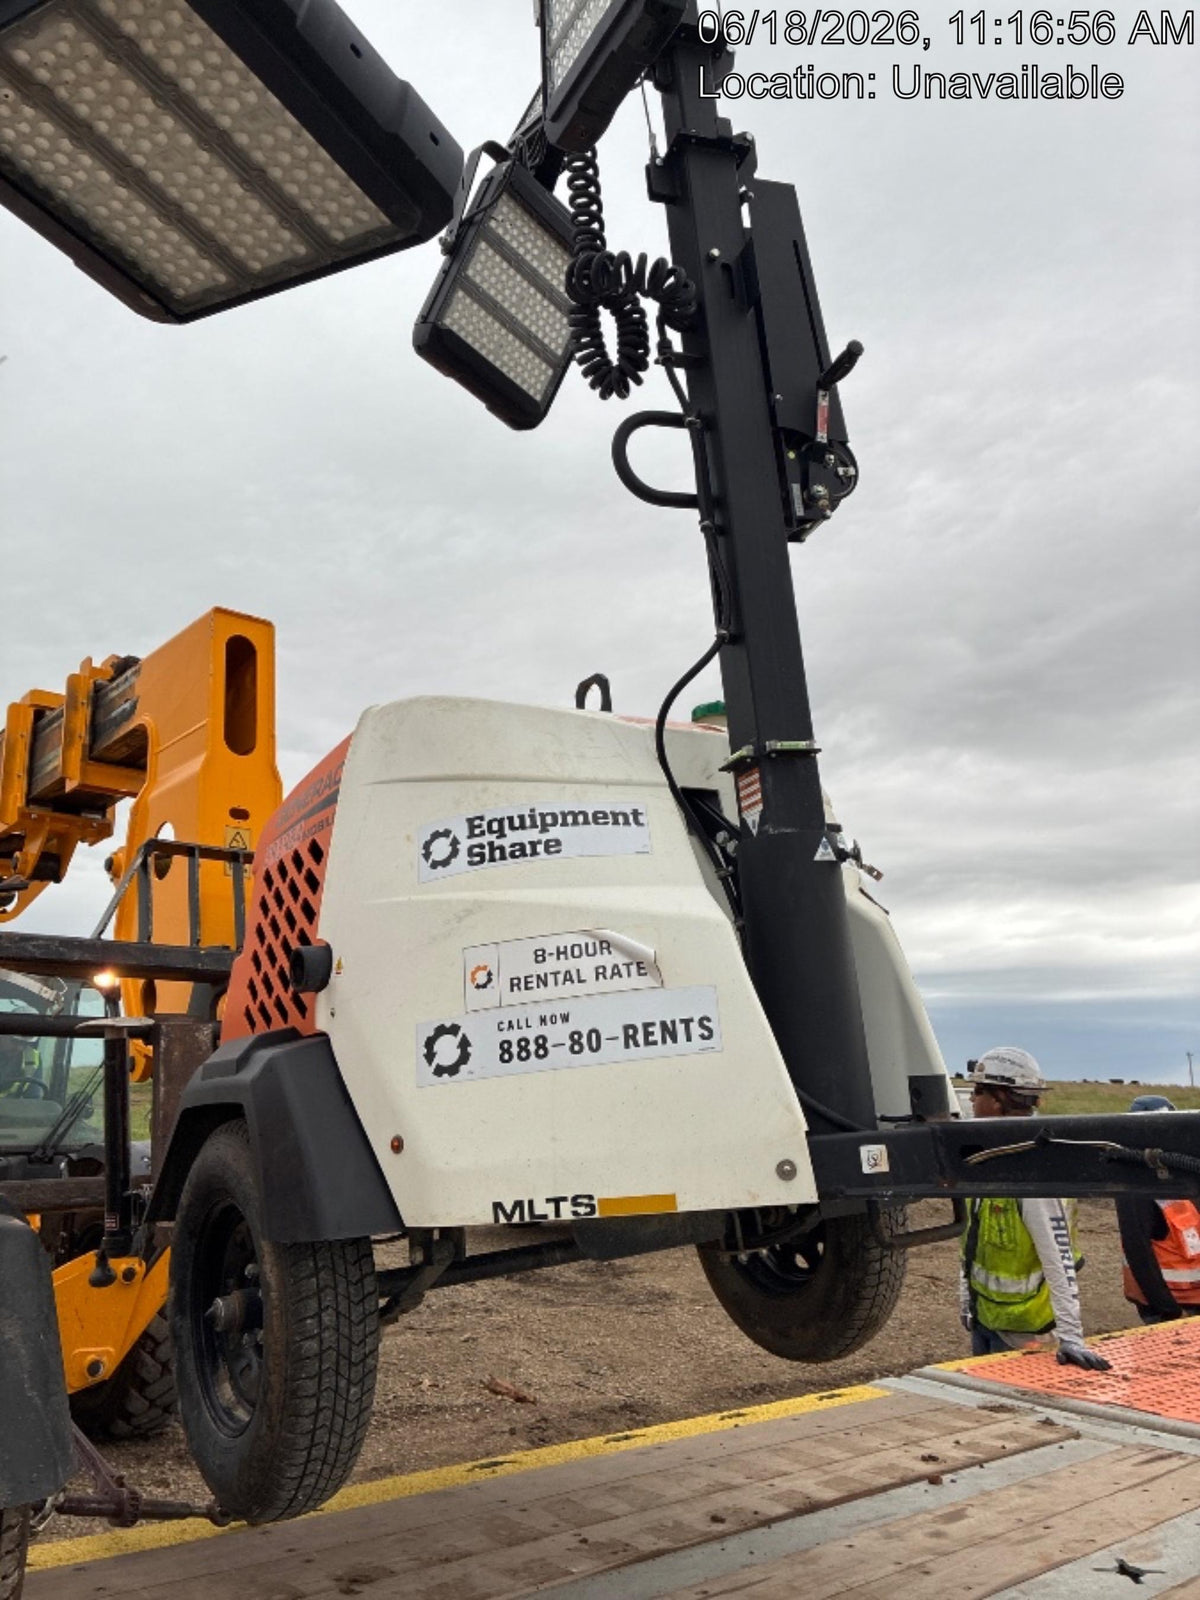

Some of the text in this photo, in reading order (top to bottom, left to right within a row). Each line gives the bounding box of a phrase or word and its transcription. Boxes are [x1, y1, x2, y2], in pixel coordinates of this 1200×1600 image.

[466, 808, 645, 839] Equipment
[466, 837, 562, 866] Share
[533, 940, 612, 964] 8-HOUR
[509, 961, 648, 992] RENTAL RATE
[497, 1012, 570, 1032] CALL NOW
[499, 1015, 714, 1064] 888-80-RENTS
[492, 1193, 597, 1224] MLTS
